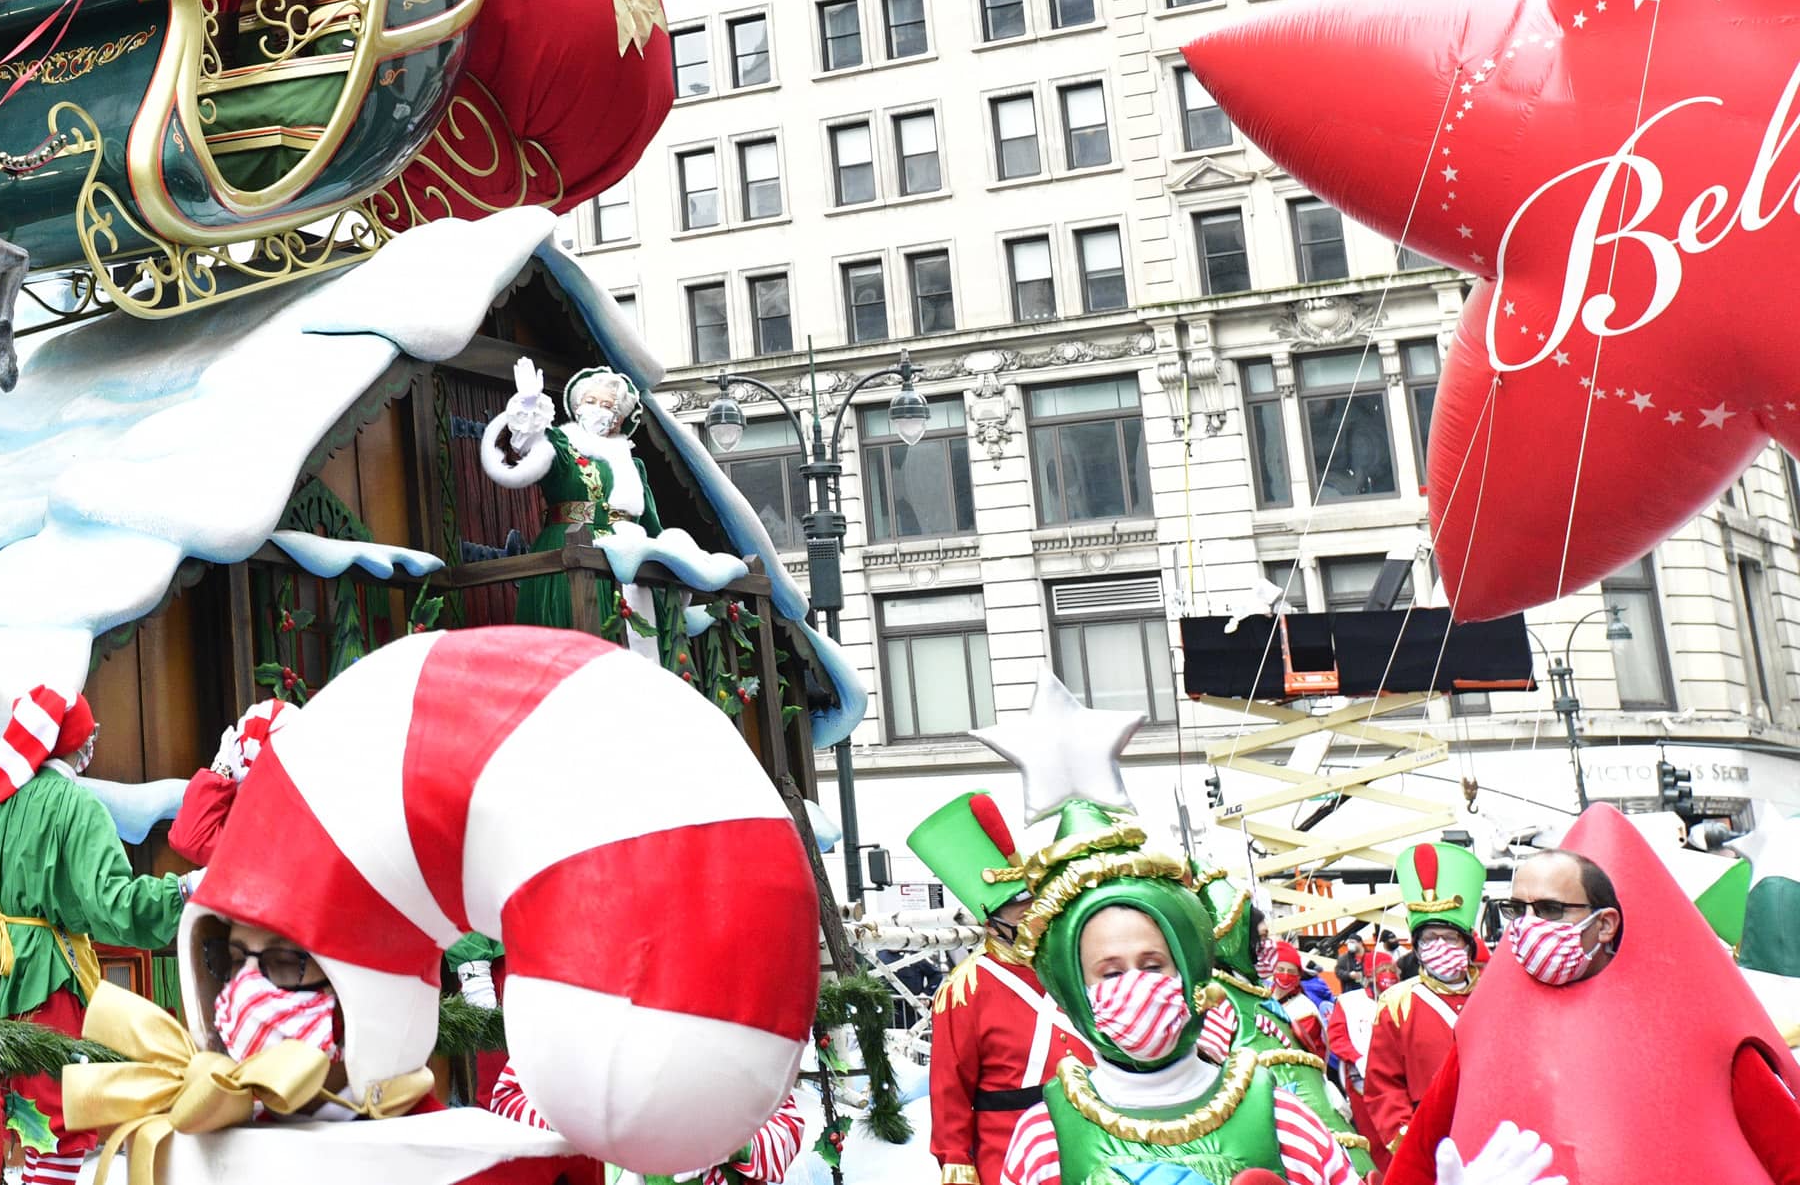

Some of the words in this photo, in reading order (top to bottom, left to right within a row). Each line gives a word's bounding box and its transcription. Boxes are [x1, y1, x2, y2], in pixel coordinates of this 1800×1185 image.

[1485, 60, 1800, 372] Bel
[1581, 763, 1705, 781] VICTO'S
[1224, 804, 1243, 816] JLG
